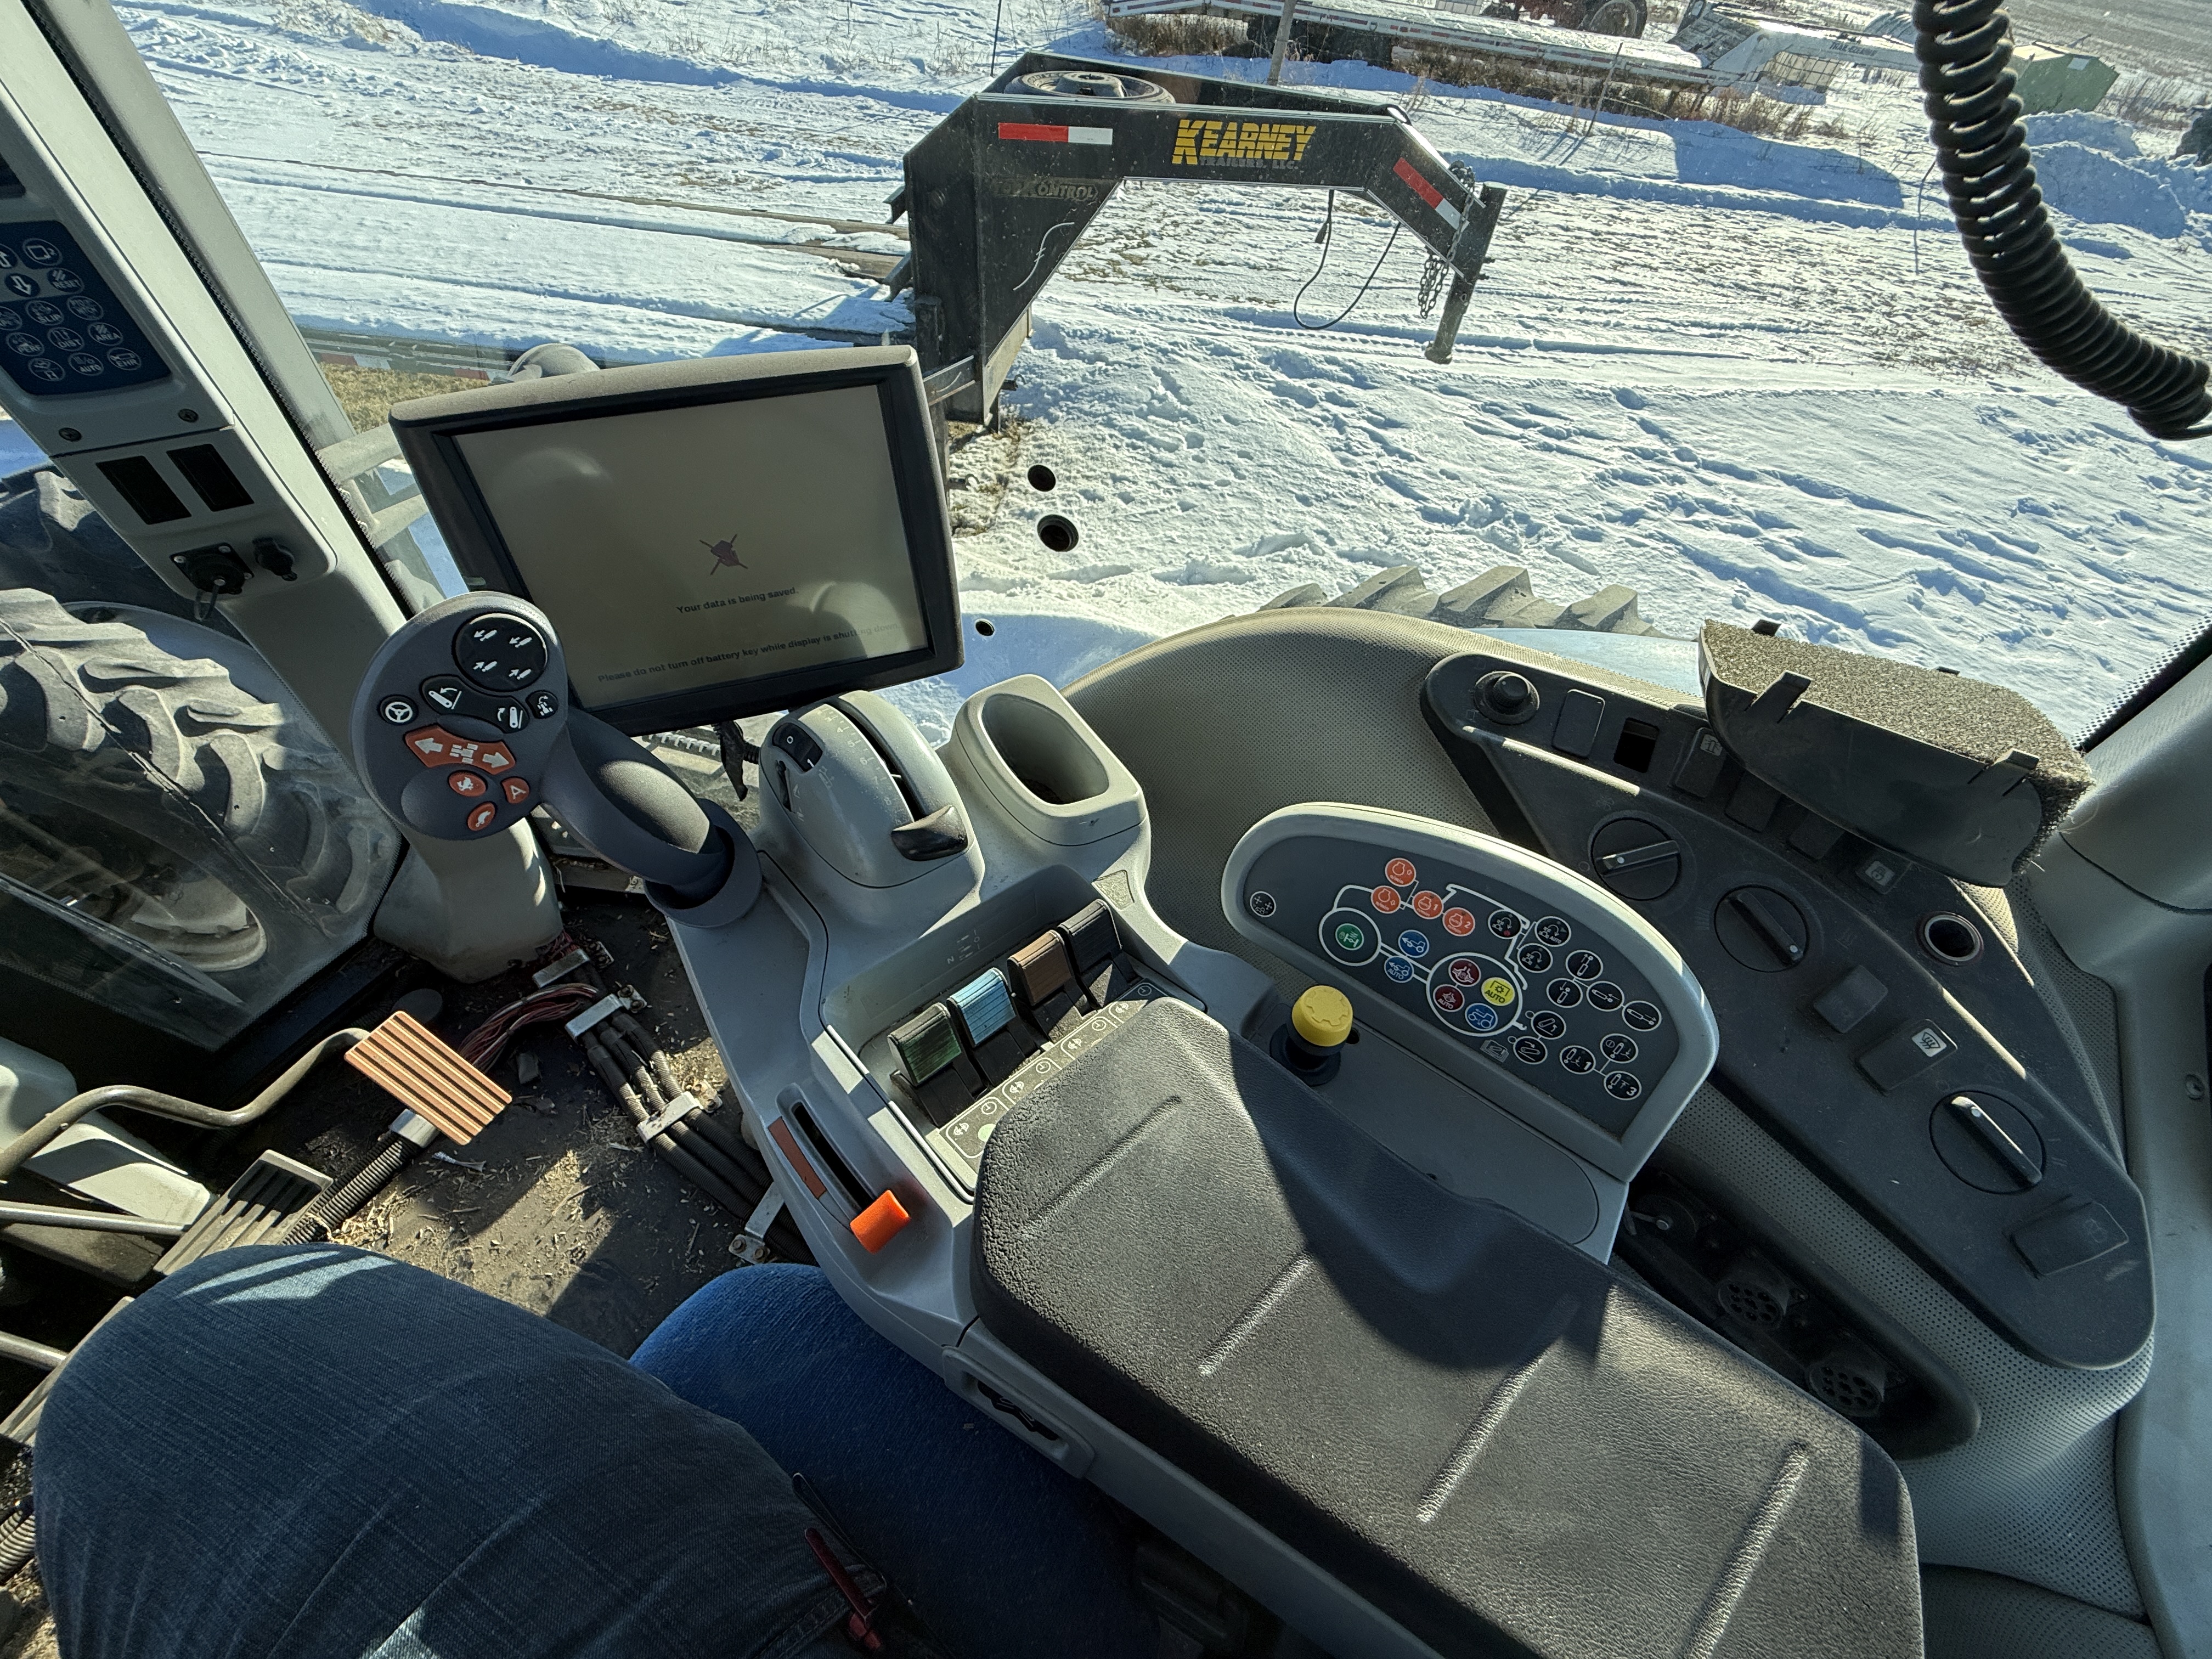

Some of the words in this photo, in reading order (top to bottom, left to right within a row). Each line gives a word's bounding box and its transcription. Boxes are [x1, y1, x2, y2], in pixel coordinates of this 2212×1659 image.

[1172, 119, 1316, 165] KEARNEY
[1272, 160, 1299, 170] LLC.
[58, 339, 81, 348] DIST
[80, 363, 101, 373] AUTO
[676, 604, 701, 614] Your
[703, 601, 726, 610] data
[727, 597, 737, 605] is
[739, 592, 766, 602] being
[768, 586, 799, 599] saved.
[597, 673, 631, 682] Please
[633, 668, 646, 676] do
[648, 664, 666, 674] not
[668, 660, 689, 670] turn
[690, 656, 704, 665] off
[706, 650, 740, 663] battery
[742, 647, 759, 657] key
[760, 643, 786, 653] while
[788, 636, 821, 648] display
[823, 633, 832, 642] is
[807, 758, 815, 768] 1
[860, 757, 868, 765] 6
[510, 785, 527, 800] A
[883, 797, 893, 806] 8
[1548, 935, 1562, 944] AUTO
[1387, 968, 1404, 980] AUTO
[1483, 989, 1506, 1003] AUTO
[1437, 997, 1454, 1009] AUTO
[1584, 1062, 1592, 1070] 1
[1627, 1087, 1637, 1096] 3
